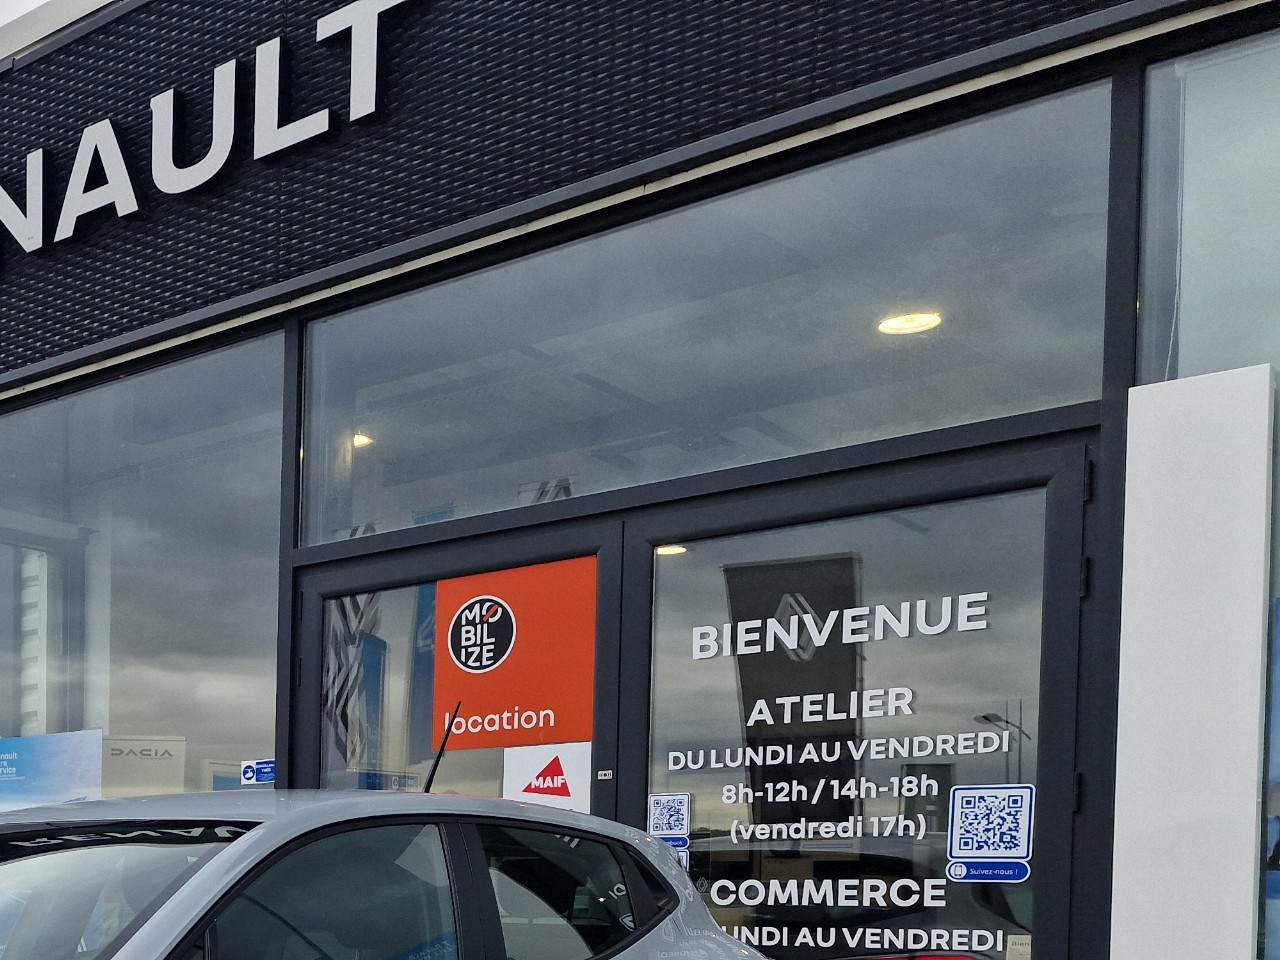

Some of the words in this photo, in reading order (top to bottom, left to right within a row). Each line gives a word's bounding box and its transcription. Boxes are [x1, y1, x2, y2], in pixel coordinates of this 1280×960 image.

[692, 592, 989, 660] BIENVENUE
[444, 706, 555, 735] location
[746, 687, 914, 727] ATELIER
[110, 748, 173, 757] DACIA
[668, 750, 705, 771] DU
[710, 745, 793, 769] LUNDI
[799, 741, 841, 763] AU
[846, 730, 1010, 761] VENDREDI
[531, 775, 567, 789] MAIF
[722, 780, 808, 804] 8h-12h
[829, 774, 939, 799] 14h-18h
[730, 815, 863, 844] (vendredi
[870, 813, 927, 840] 17h)
[710, 878, 947, 907] COMMERCE
[794, 928, 836, 948] AU
[842, 928, 1004, 951] VENDREDI
